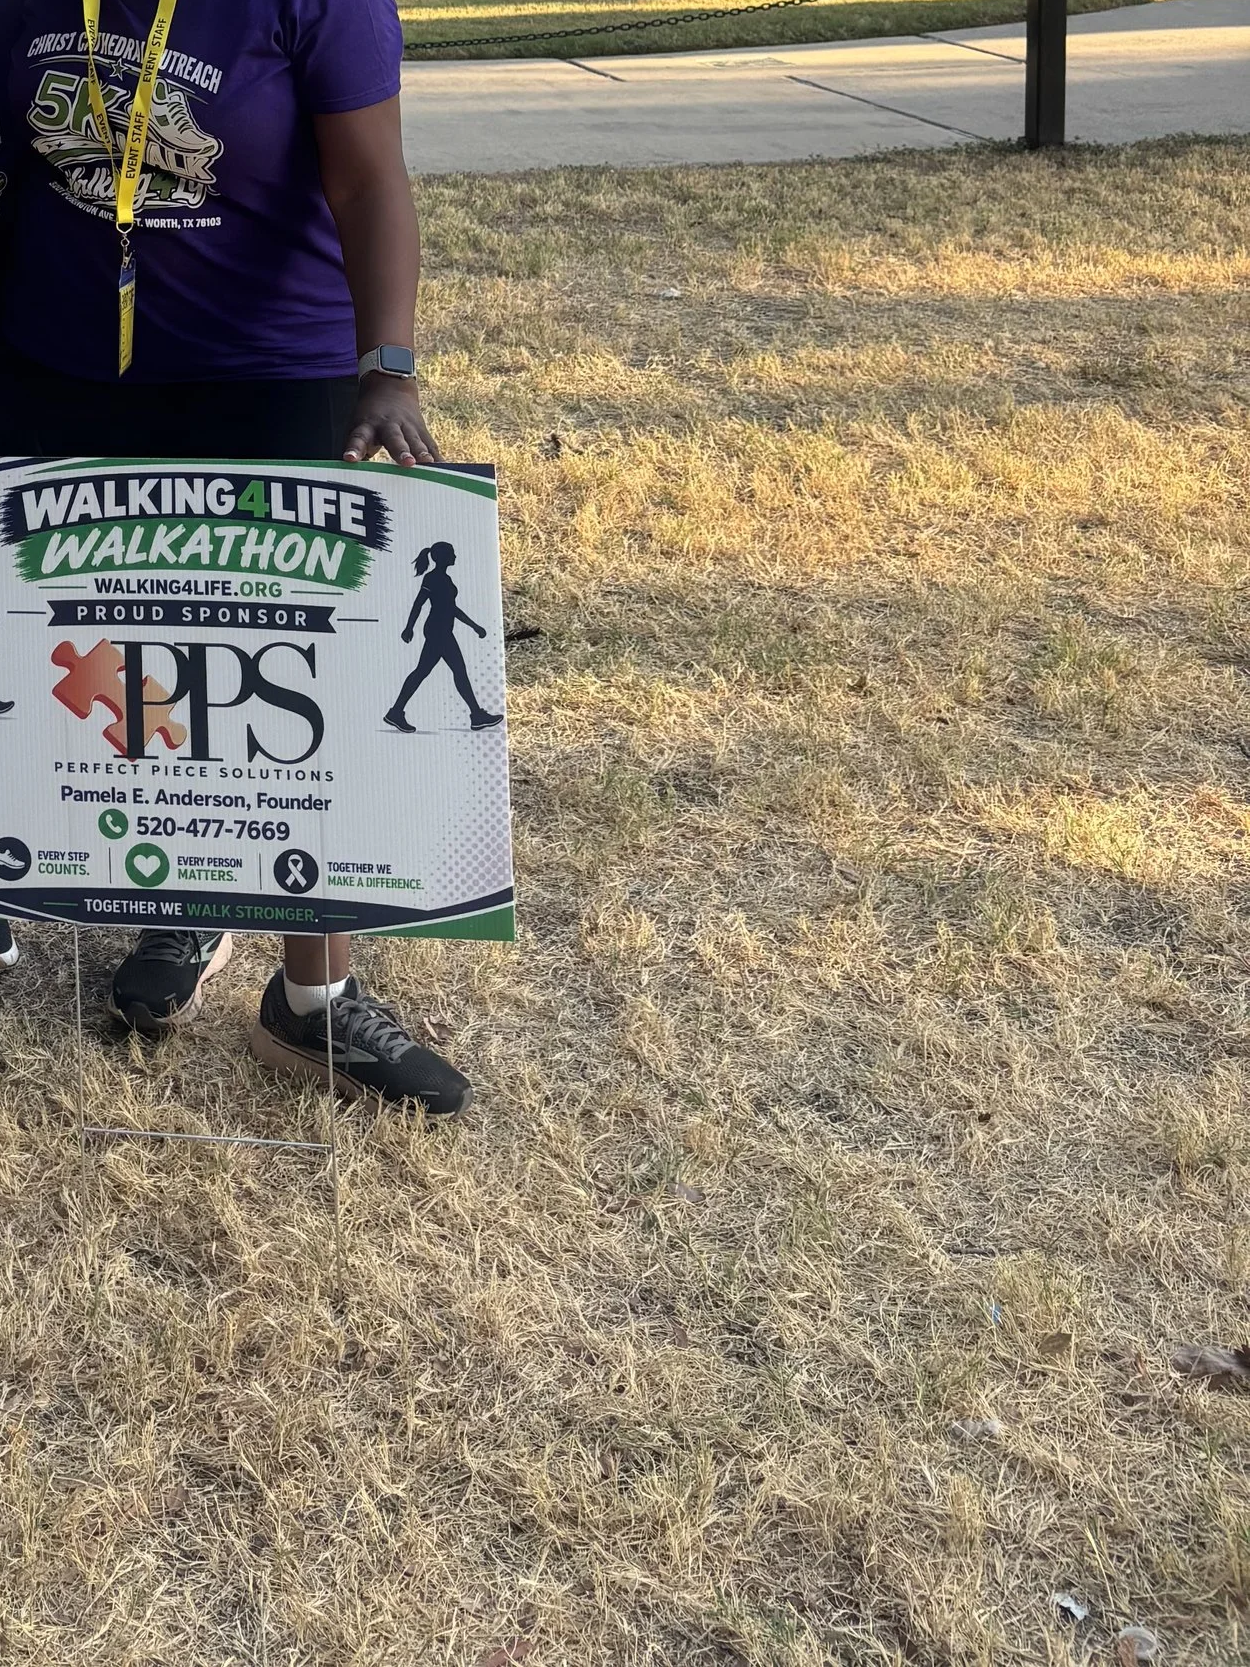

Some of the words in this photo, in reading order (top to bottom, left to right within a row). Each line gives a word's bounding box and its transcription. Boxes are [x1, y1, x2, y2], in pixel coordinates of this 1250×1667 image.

[27, 32, 78, 58] CHRIST
[77, 31, 146, 65] CHEDRA
[160, 48, 223, 95] UTREACH
[143, 50, 159, 83] EVENT
[151, 18, 167, 49] STAFF
[27, 69, 131, 141] 5K
[131, 111, 146, 144] STAFF
[125, 147, 140, 179] EVENT
[145, 218, 181, 230] WORTH,
[182, 218, 194, 227] TX
[195, 217, 222, 227] 76103
[22, 477, 367, 537] WALKING4LIFE
[41, 523, 346, 581] WALKATHON
[94, 578, 283, 598] WALKING4LIFE.ORG
[77, 605, 165, 621] PROUD
[181, 607, 308, 627] SPONSOR
[111, 640, 325, 764] PPS
[54, 762, 141, 775] PERFECT
[151, 765, 209, 777] PIECE
[219, 767, 335, 782] SOLUTIONS
[60, 785, 127, 804] Pamela
[132, 787, 150, 804] E.
[154, 789, 252, 811] Anderson,
[256, 792, 332, 811] Founder
[136, 816, 291, 841] 520-477-7669
[37, 850, 66, 861] EVERY
[67, 852, 90, 862] STEP
[177, 856, 205, 867] EVERY
[207, 857, 243, 868] PERSON
[327, 861, 374, 874] TOGETHER
[376, 864, 392, 875] WE
[38, 862, 90, 876] COUNTS.
[177, 868, 238, 882] MATTERS.
[327, 875, 355, 887] MAKE
[357, 877, 365, 888] A
[366, 877, 425, 890] DIFFERENCE.
[84, 898, 157, 914] TOGETHER
[159, 901, 183, 916] WE
[186, 903, 231, 918] WALK
[235, 905, 319, 923] STRONGER.
